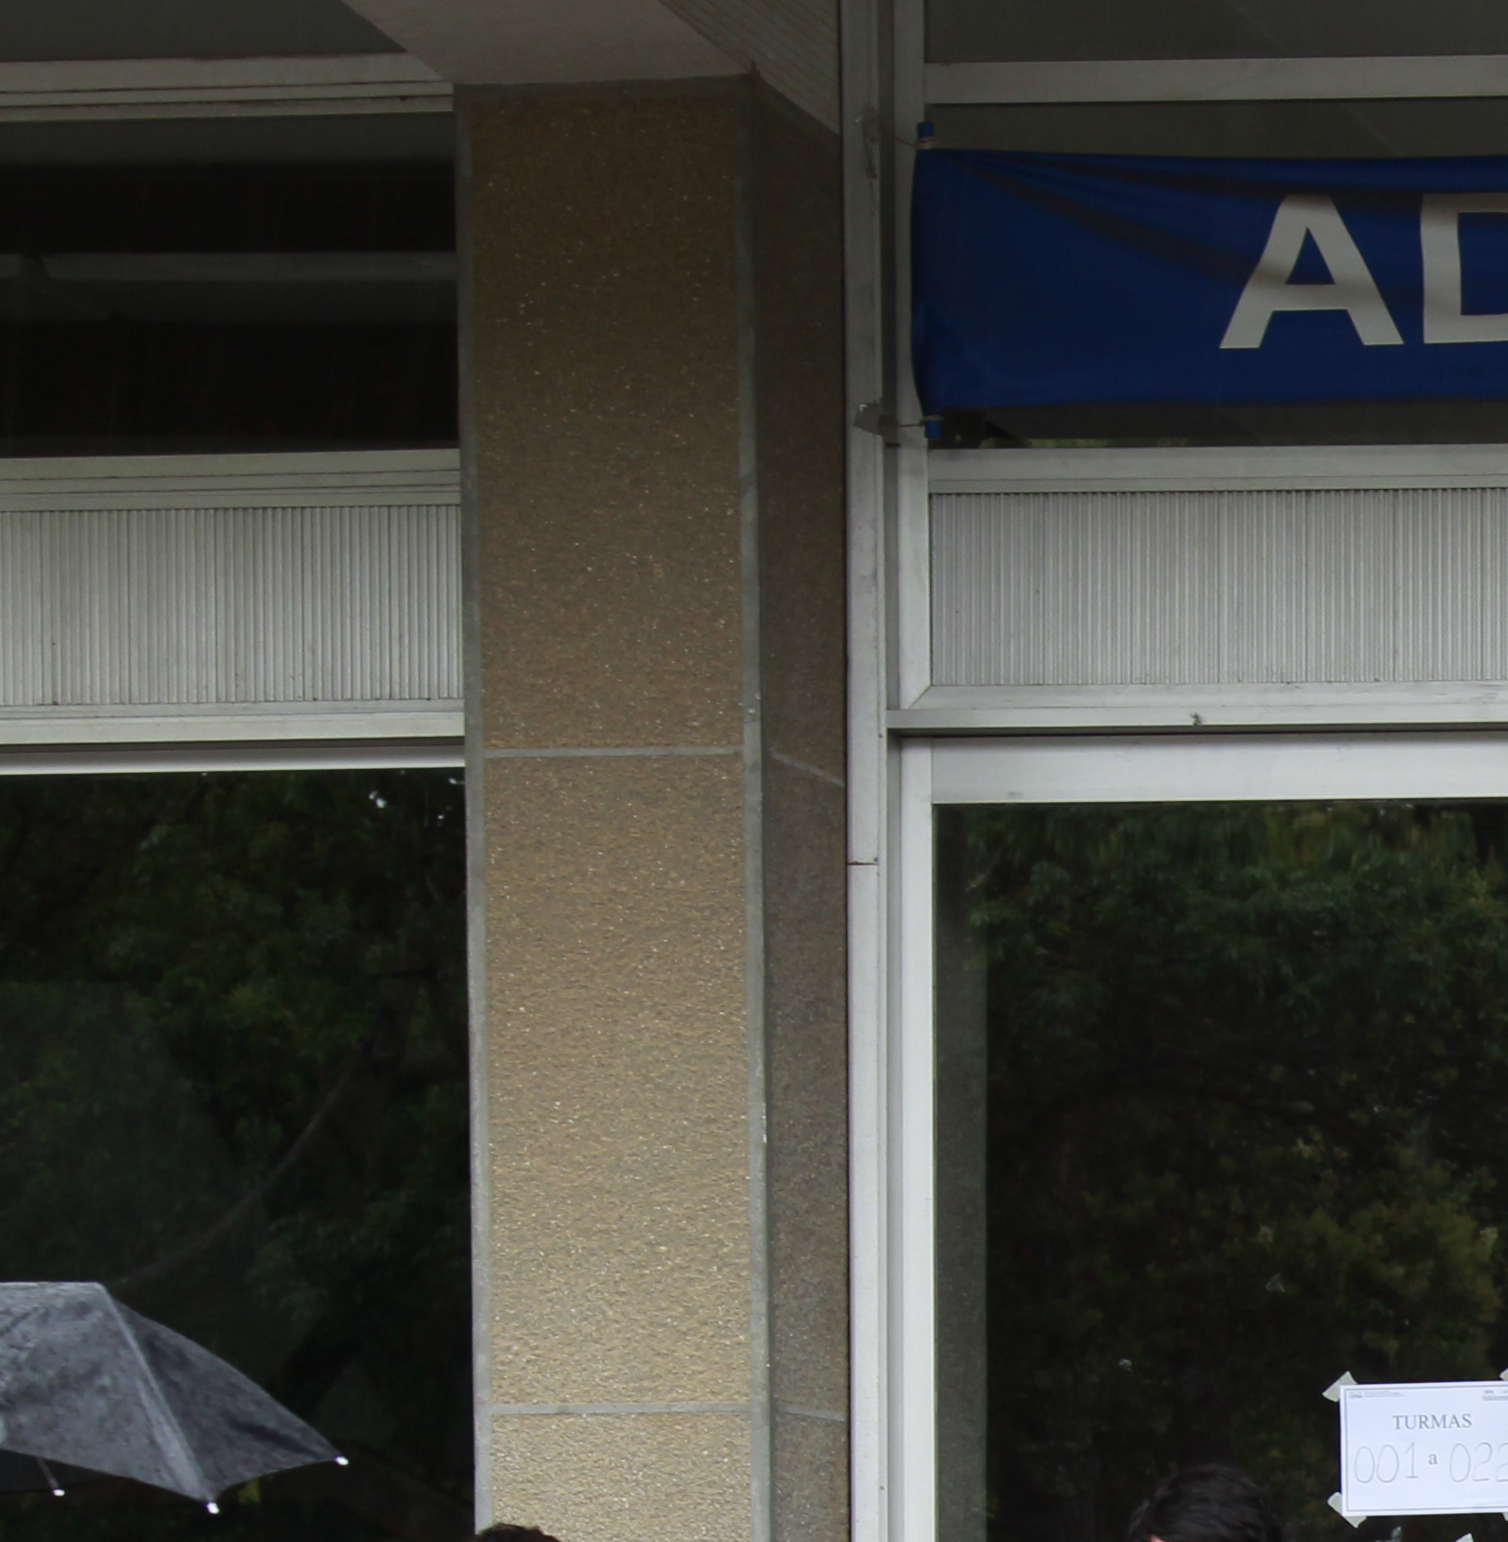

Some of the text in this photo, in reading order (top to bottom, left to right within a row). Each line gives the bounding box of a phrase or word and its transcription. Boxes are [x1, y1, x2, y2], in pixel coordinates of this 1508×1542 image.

[1392, 1414, 1472, 1430] TURMAS
[1354, 1441, 1419, 1484] 001
[1428, 1453, 1439, 1465] a
